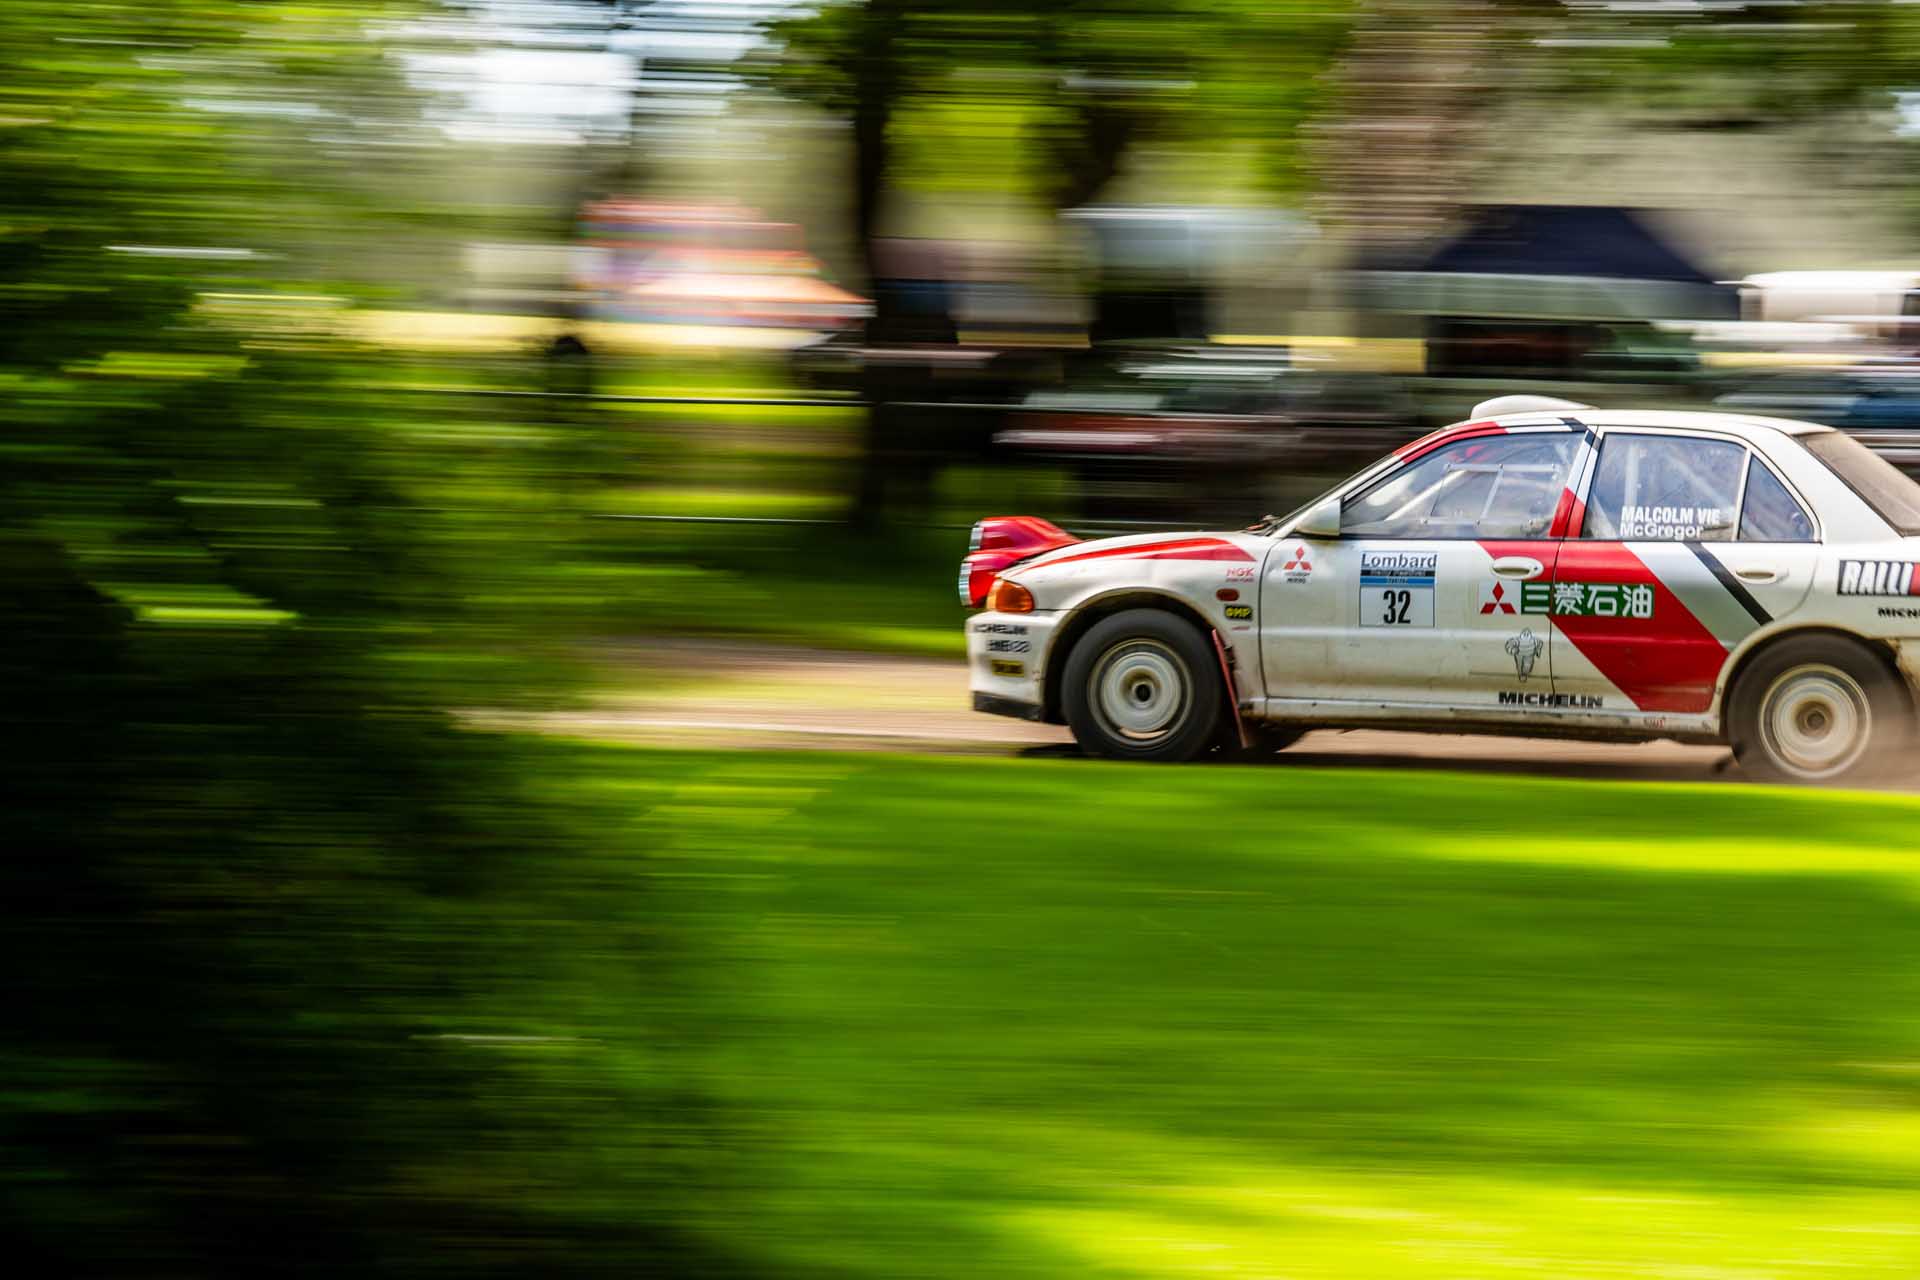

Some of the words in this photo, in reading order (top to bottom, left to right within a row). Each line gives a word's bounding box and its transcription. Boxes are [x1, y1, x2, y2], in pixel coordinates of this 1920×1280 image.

[1621, 506, 1694, 524] MALCOLM
[1620, 522, 1704, 541] McGregor
[1361, 553, 1438, 569] Lombard
[1383, 590, 1411, 624] 32
[1523, 582, 1653, 618] 三菱石油
[1498, 691, 1603, 708] MICHELIN
